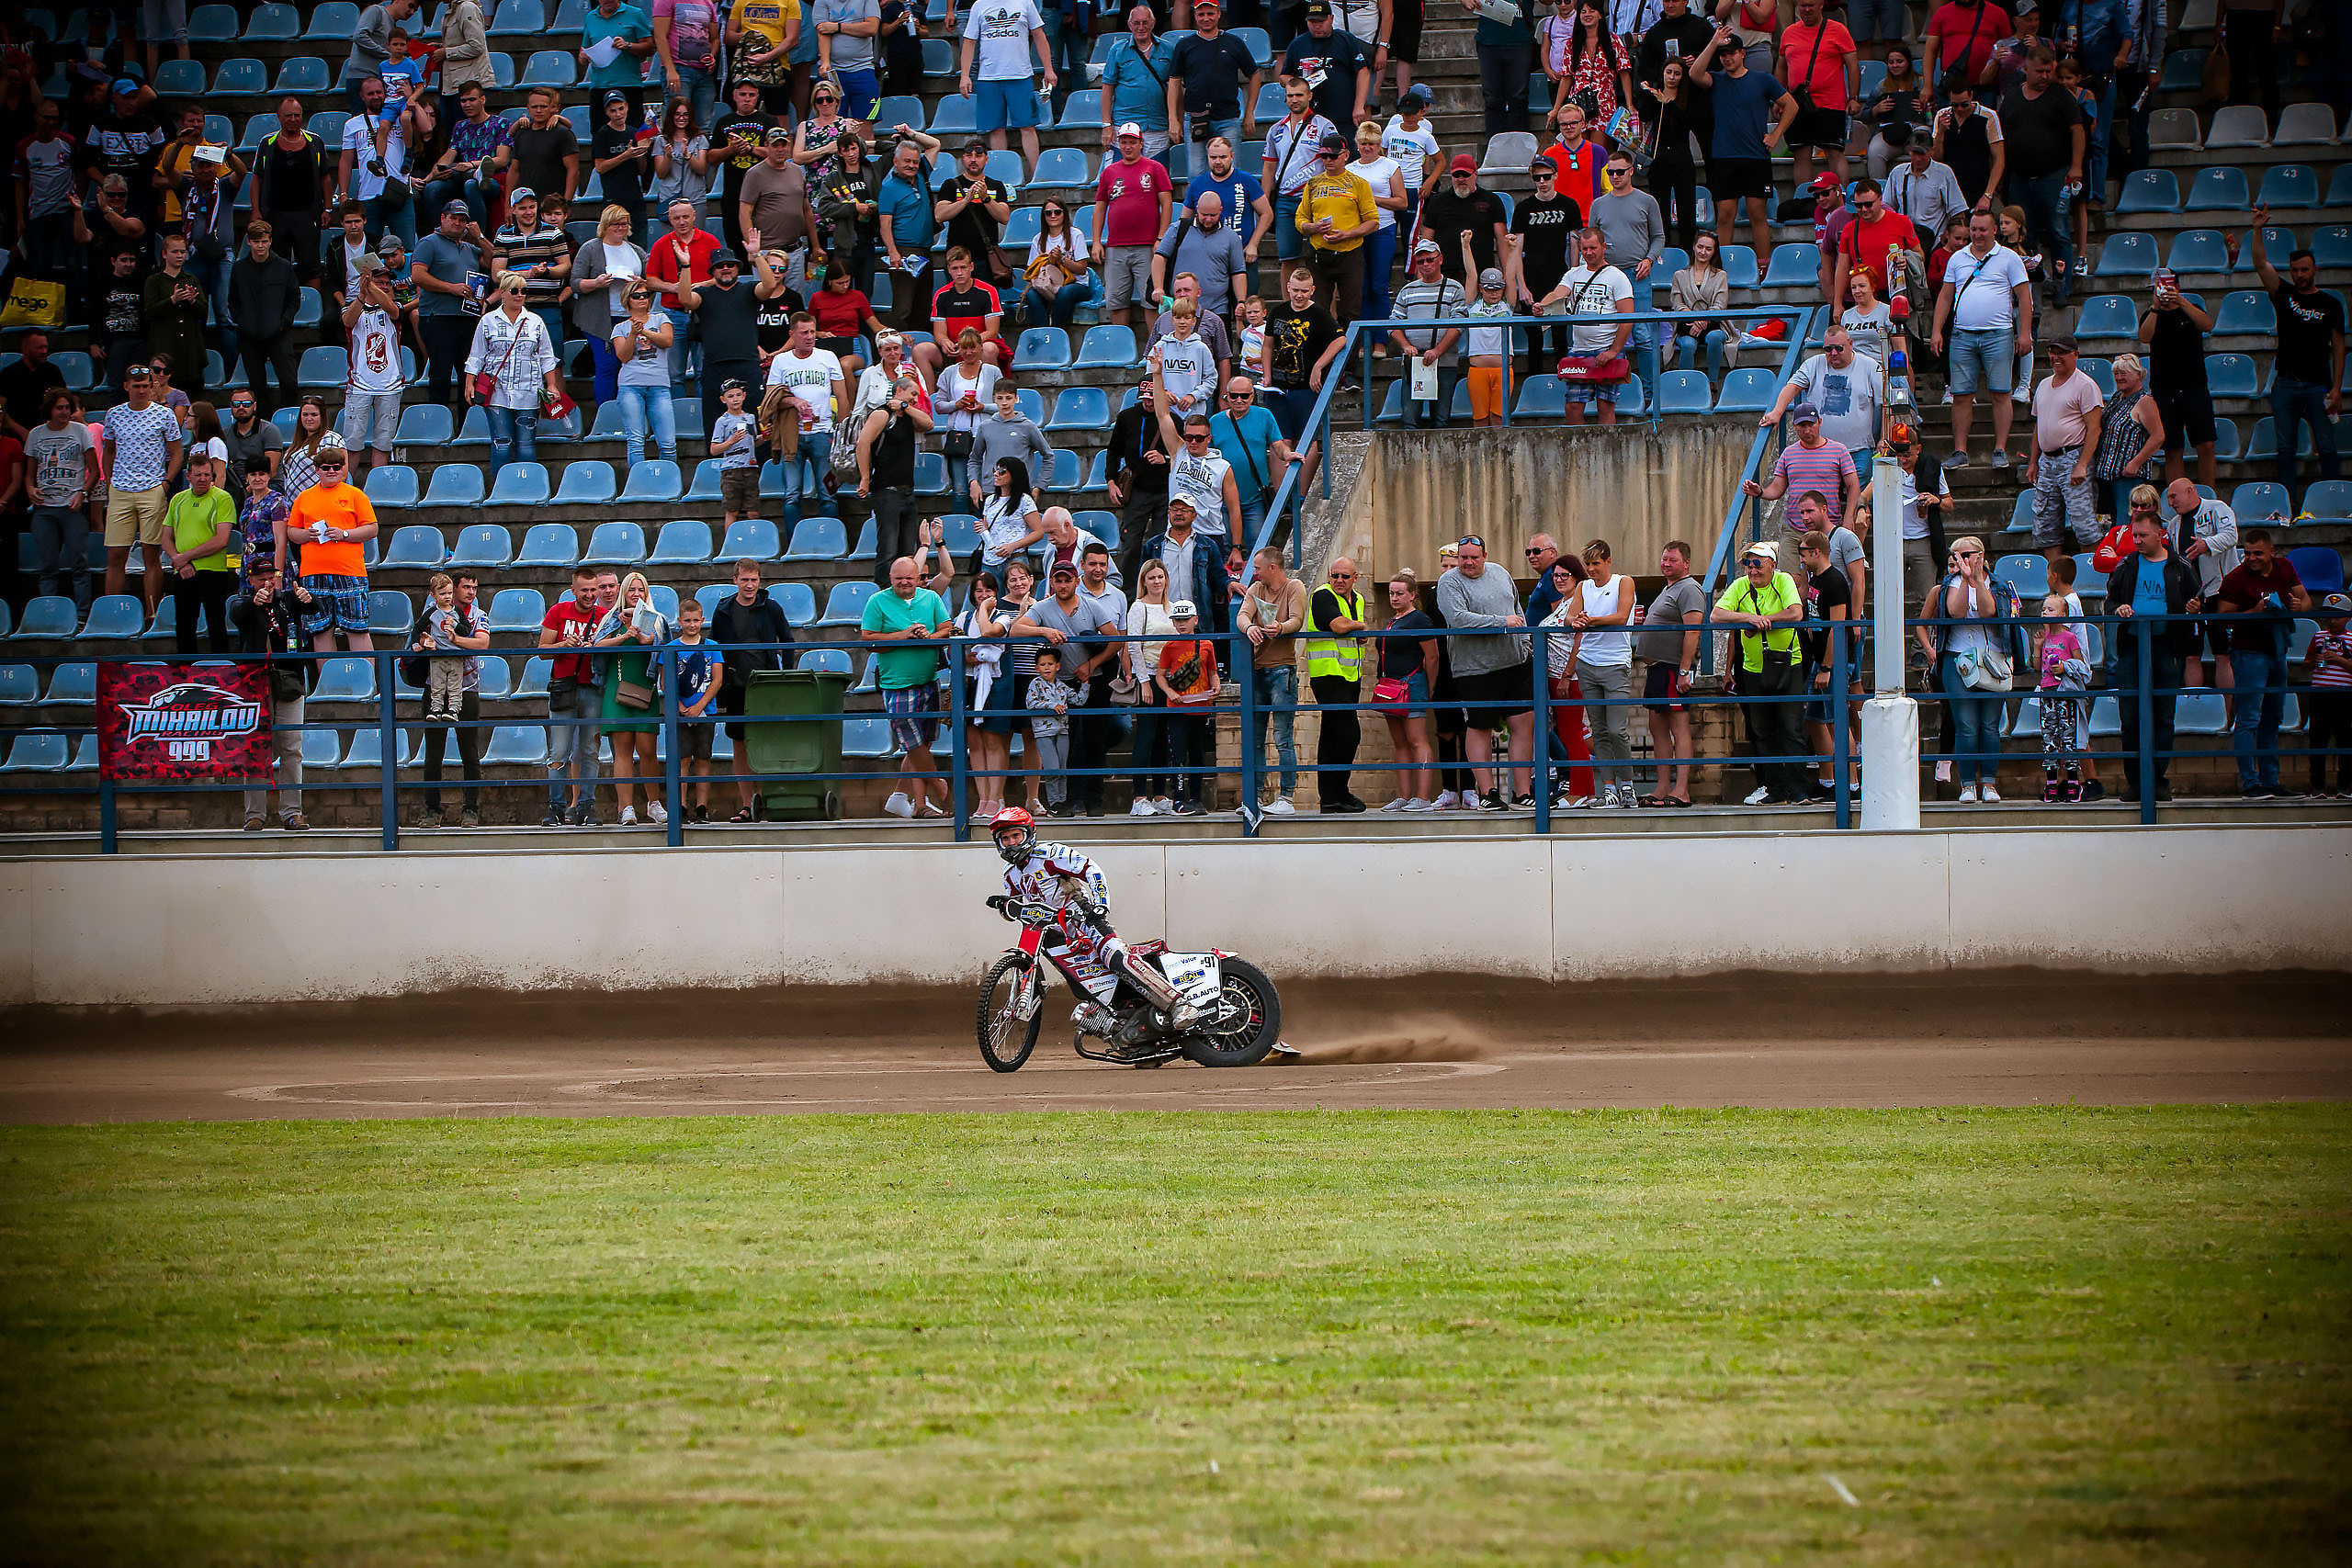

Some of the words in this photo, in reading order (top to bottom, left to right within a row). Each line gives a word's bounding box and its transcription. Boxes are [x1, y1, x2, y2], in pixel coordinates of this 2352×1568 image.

[987, 28, 1019, 38] adidas
[2283, 169, 2298, 178] 43
[850, 181, 866, 192] GAP
[1529, 210, 1565, 225] GUESS
[2289, 297, 2325, 321] Wrangler
[1044, 335, 1050, 344] 3
[1164, 359, 1195, 370] NASA
[805, 370, 826, 387] HIGH
[1679, 378, 1687, 387] 3
[1747, 375, 1753, 384] 2
[2, 671, 14, 680] 16
[171, 702, 218, 711] OLEG
[169, 741, 210, 761] 999
